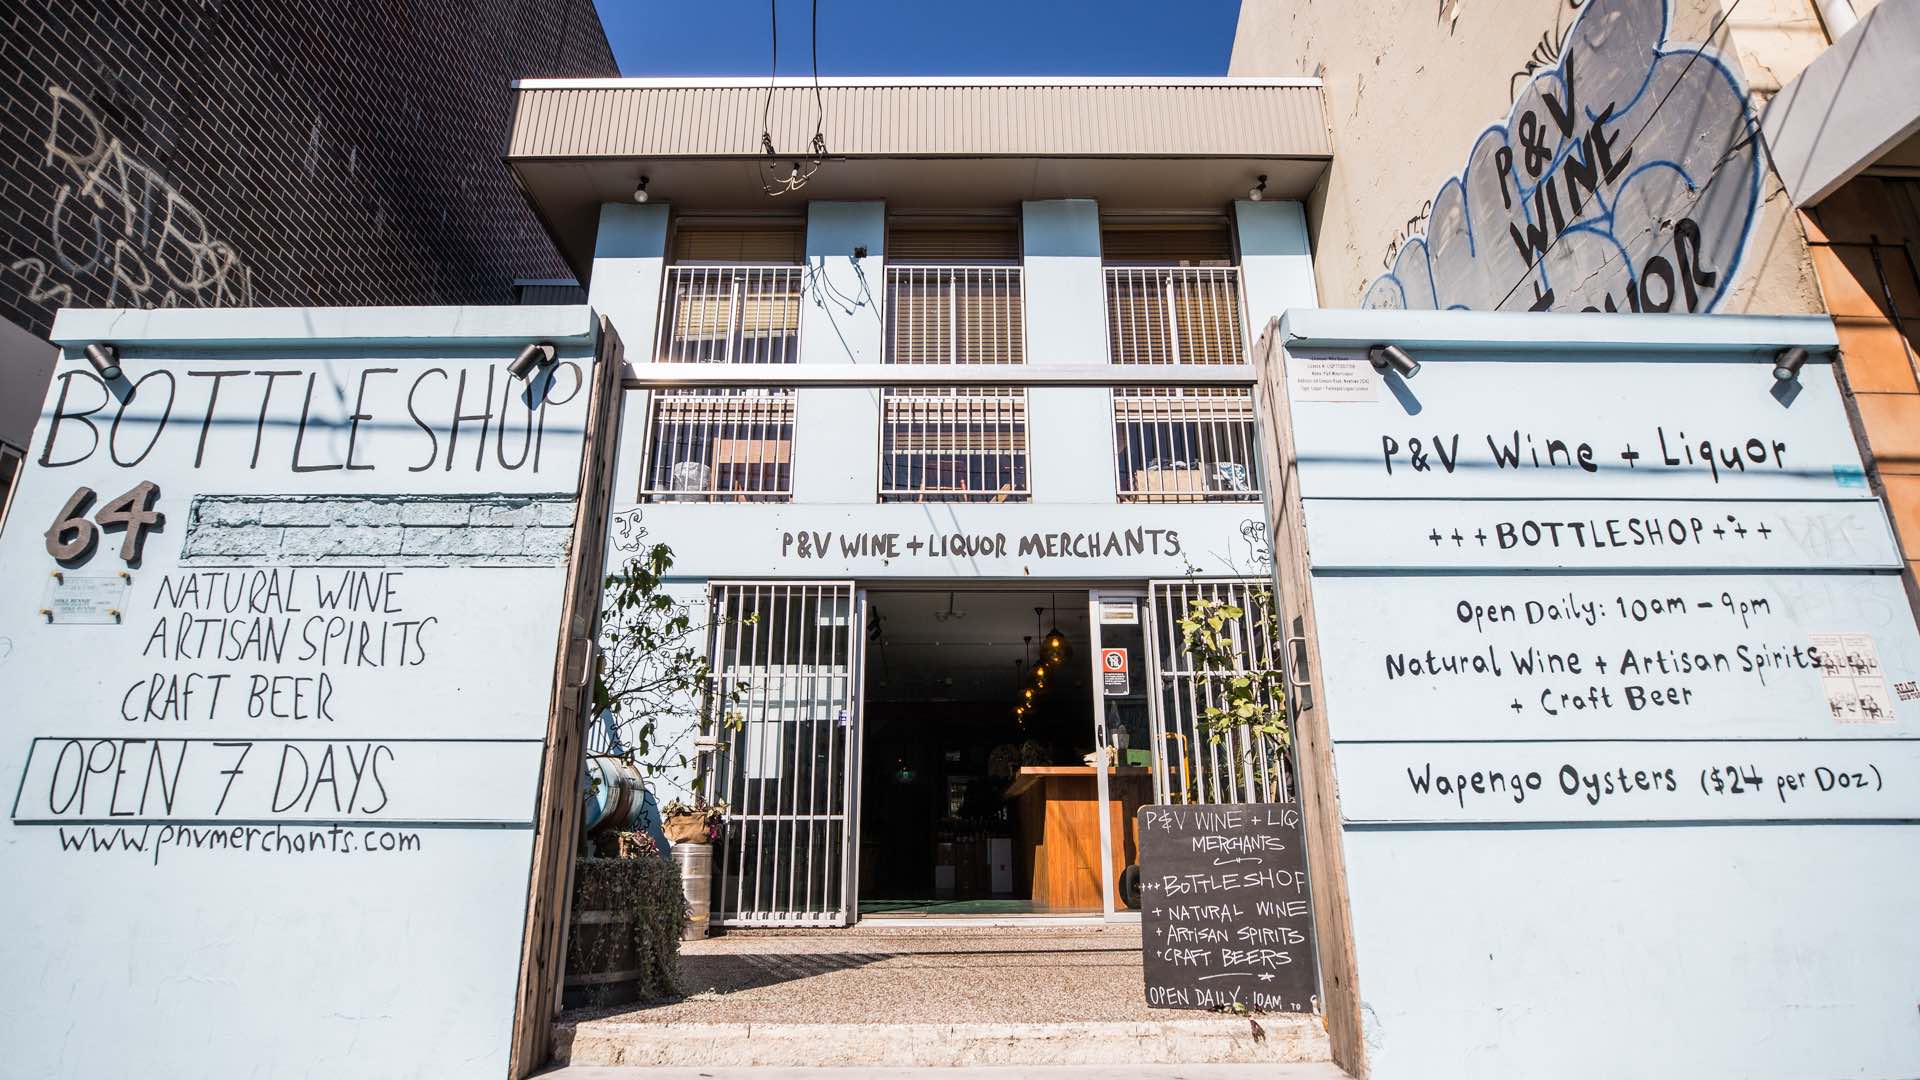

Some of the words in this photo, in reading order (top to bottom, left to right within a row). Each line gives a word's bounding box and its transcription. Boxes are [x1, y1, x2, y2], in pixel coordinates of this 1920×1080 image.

[1495, 48, 1574, 210] P&V
[1510, 101, 1632, 270] WINE
[38, 361, 582, 474] BOTTLESHOP
[1382, 432, 1459, 475] P&V
[1487, 429, 1598, 473] Wine
[1657, 426, 1787, 484] Liquor
[45, 480, 165, 568] 64
[782, 532, 831, 559] P&V
[840, 532, 901, 558] WINE
[928, 531, 1008, 558] LIQUOR
[1018, 526, 1182, 559] MERCHANTS
[1495, 516, 1704, 550] BOTTLESHOP
[154, 568, 301, 613] NATURAL
[316, 572, 403, 613] WINE
[1456, 598, 1516, 632] Open
[1527, 593, 1606, 626] Daily:
[1616, 595, 1687, 622] 10am
[1722, 592, 1771, 629] 9pm
[143, 612, 290, 664] ARTISAN
[298, 616, 438, 668] SPIRITS
[1386, 645, 1502, 680] Natural
[1510, 647, 1583, 676] Wine
[1619, 645, 1730, 676] Artisan
[1738, 643, 1822, 686] Spirits
[121, 673, 231, 722] CRAFT
[247, 673, 334, 722] BEER
[1540, 688, 1614, 716] Craft
[1624, 685, 1694, 713] Beer
[49, 738, 187, 816] OPEN
[213, 741, 253, 816] 7
[271, 742, 395, 814] DAYS
[1407, 763, 1543, 808] Wapengo
[1558, 762, 1679, 806] Oysters
[1700, 768, 1764, 797] ($24
[1776, 772, 1806, 803] per
[1814, 763, 1884, 793] Doz)
[1146, 809, 1186, 834] P&V
[1195, 810, 1243, 832] WINE
[1192, 835, 1285, 855] MERCHANTS
[1168, 903, 1244, 923] NATURAL
[1256, 900, 1308, 917] WINE
[1167, 924, 1229, 946] ARTISAN
[1236, 926, 1305, 946] SPIRITS
[1164, 948, 1212, 967] CRAFT
[1221, 949, 1292, 970] BEERS
[1149, 987, 1190, 1006] OPEN
